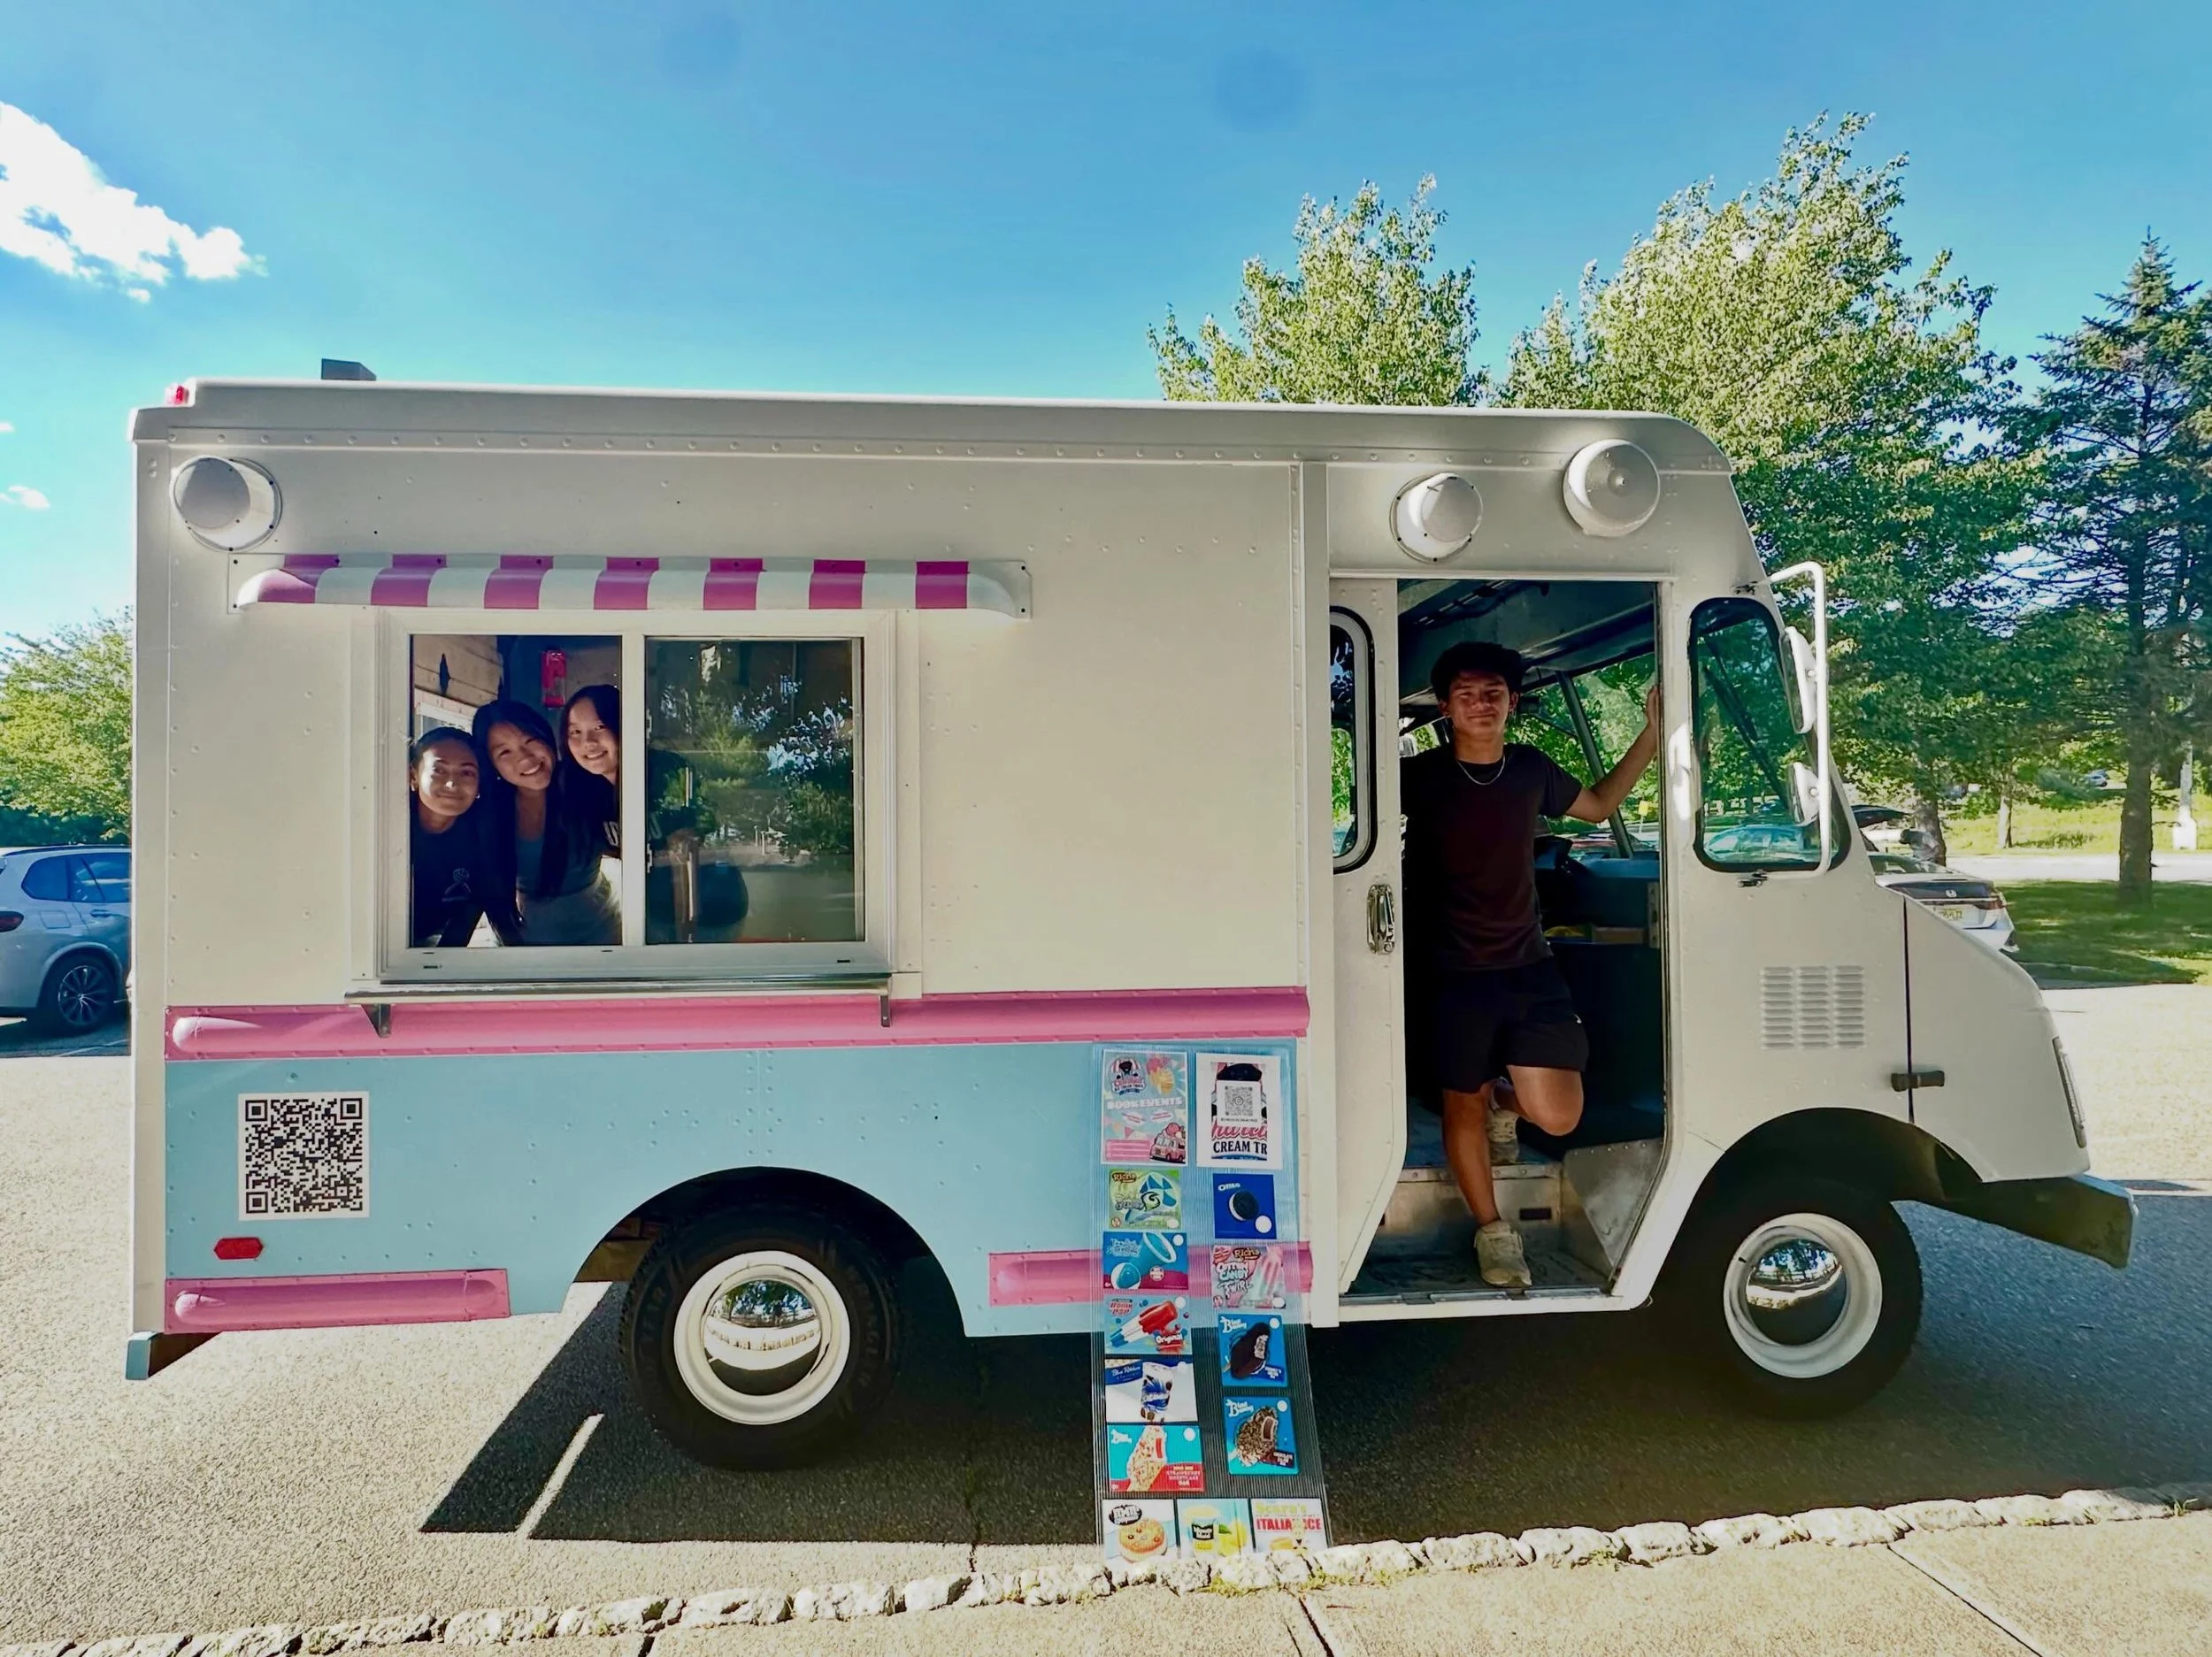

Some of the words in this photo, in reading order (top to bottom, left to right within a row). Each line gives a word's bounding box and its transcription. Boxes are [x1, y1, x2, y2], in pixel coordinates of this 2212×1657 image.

[1107, 1101, 1140, 1109] BOOK
[1141, 1097, 1183, 1108] EVENTS
[1213, 1140, 1250, 1153] CREAM
[1254, 1141, 1267, 1155] TR
[1156, 1333, 1183, 1344] Original
[1256, 1517, 1294, 1530] ITALIA
